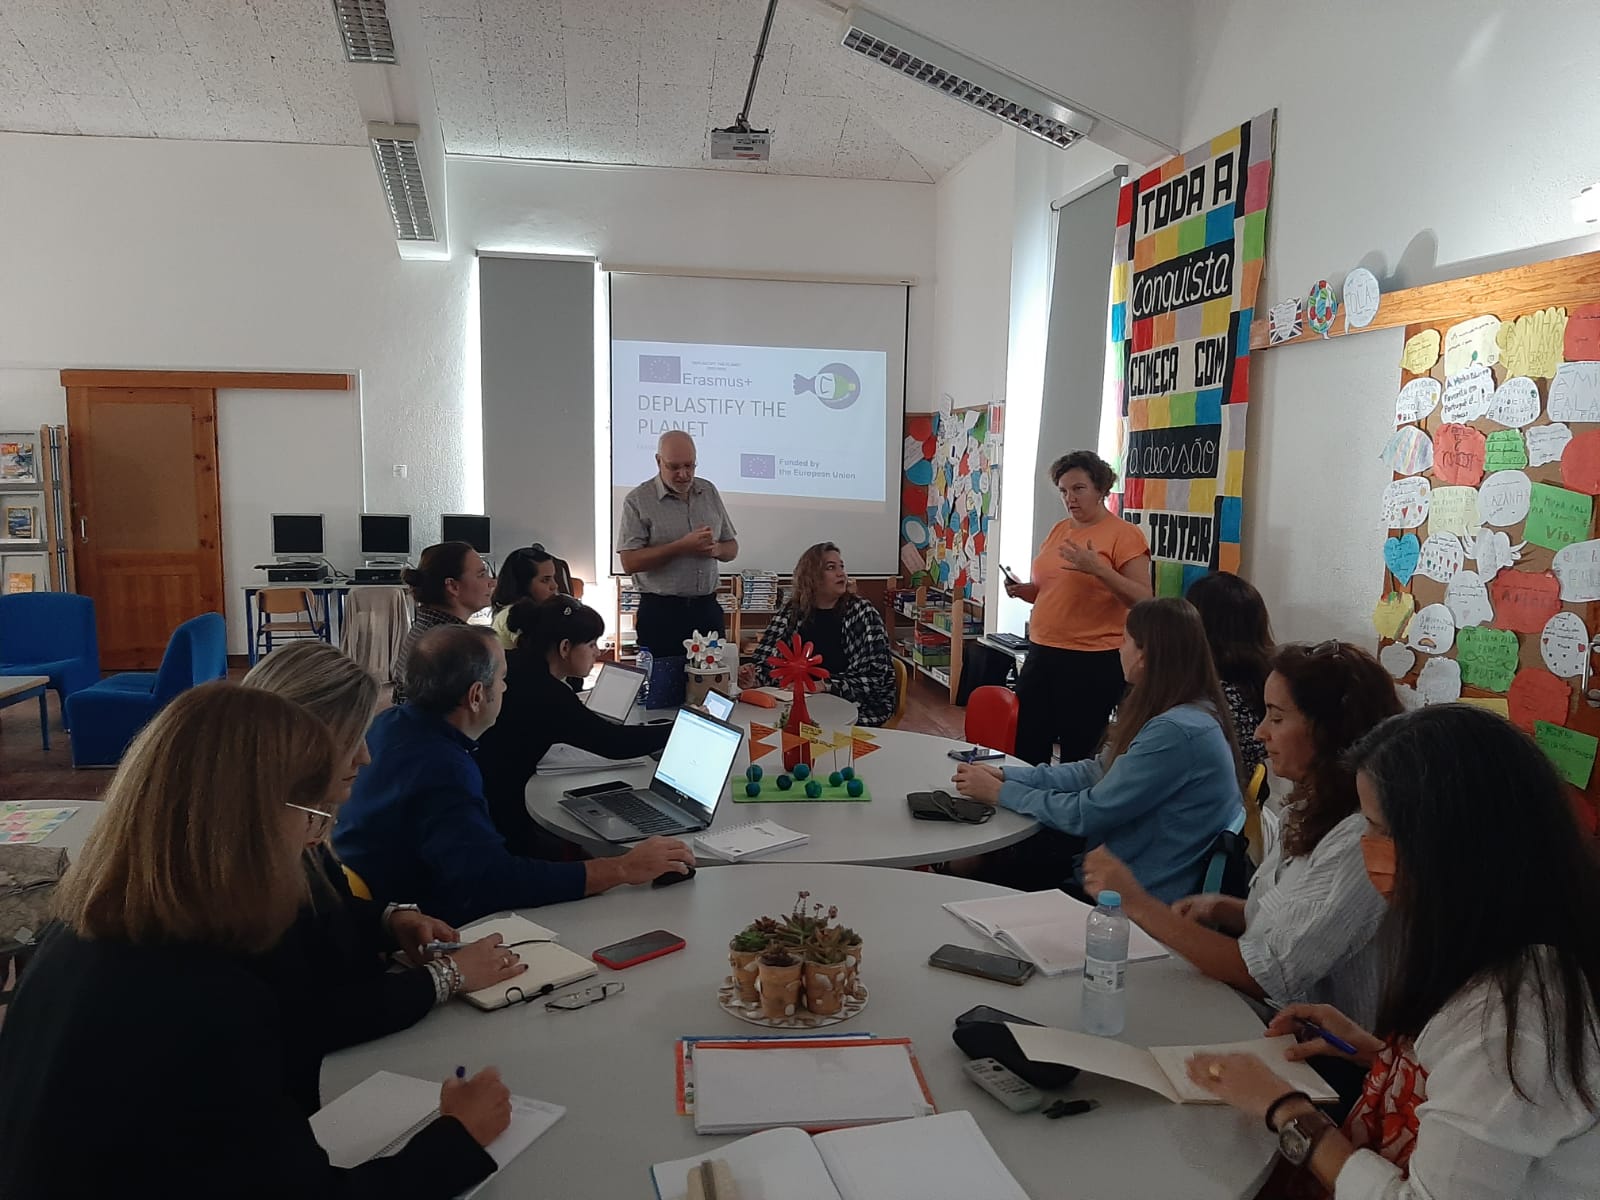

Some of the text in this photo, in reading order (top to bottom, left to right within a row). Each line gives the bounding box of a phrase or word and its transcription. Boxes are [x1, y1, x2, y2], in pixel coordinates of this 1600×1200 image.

[1141, 151, 1234, 234] TODA A
[1130, 336, 1226, 397] COMEÇA COM
[683, 373, 753, 388] Erasmus+
[638, 395, 787, 418] DEPLASTIFY THE
[638, 418, 708, 437] PLANET
[779, 458, 820, 469] Funded by
[1143, 437, 1217, 475] decisão
[779, 468, 856, 480] the European Union
[1149, 512, 1212, 563] TENTAR
